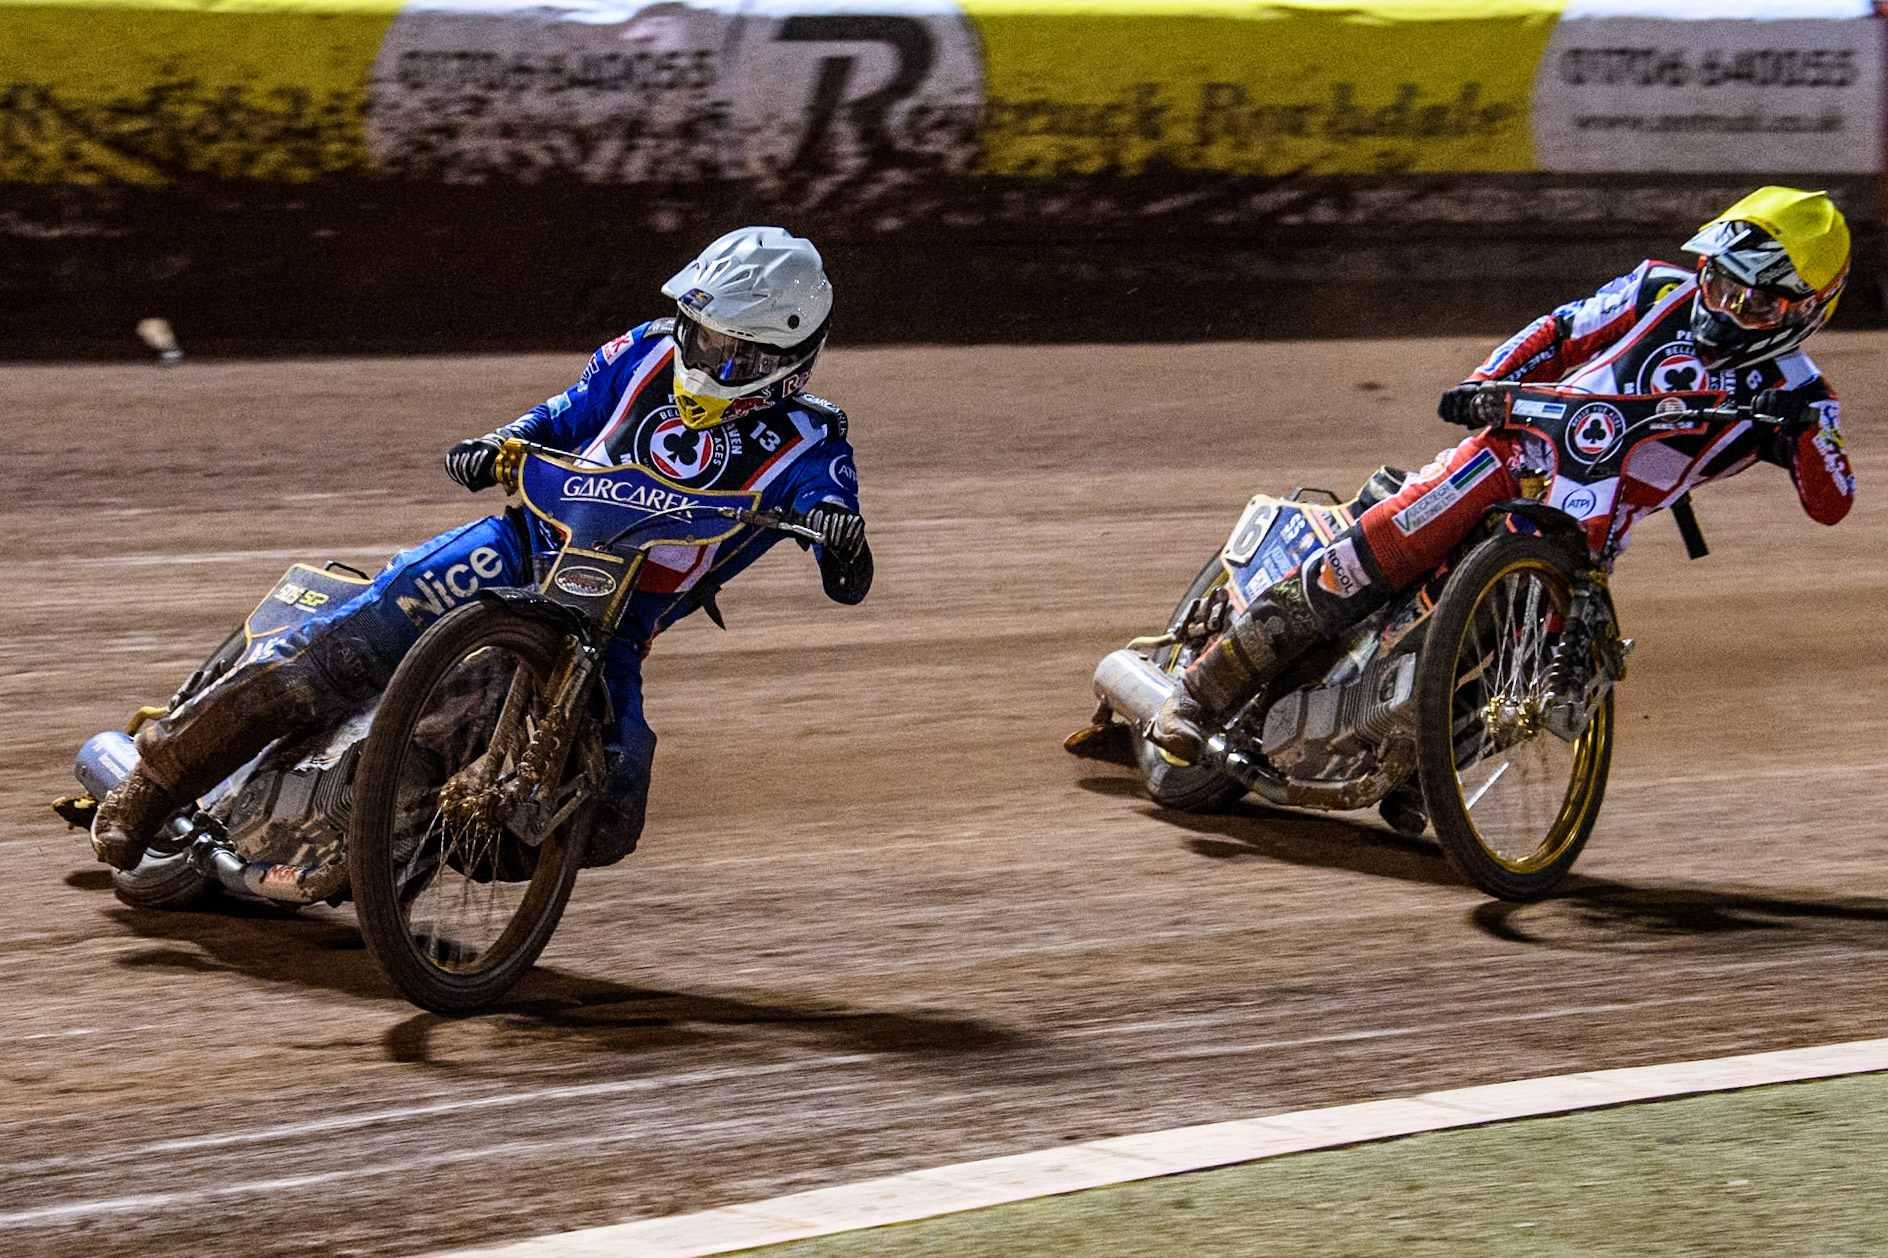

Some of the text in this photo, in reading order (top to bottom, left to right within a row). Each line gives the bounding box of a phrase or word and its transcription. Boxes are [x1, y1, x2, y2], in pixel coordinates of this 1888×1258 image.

[714, 437, 724, 465] ACES
[750, 420, 781, 452] 13
[563, 475, 699, 519] GARCAREK
[1232, 505, 1271, 556] 6
[396, 546, 503, 632] Nice
[1327, 548, 1355, 593] ROCOL
